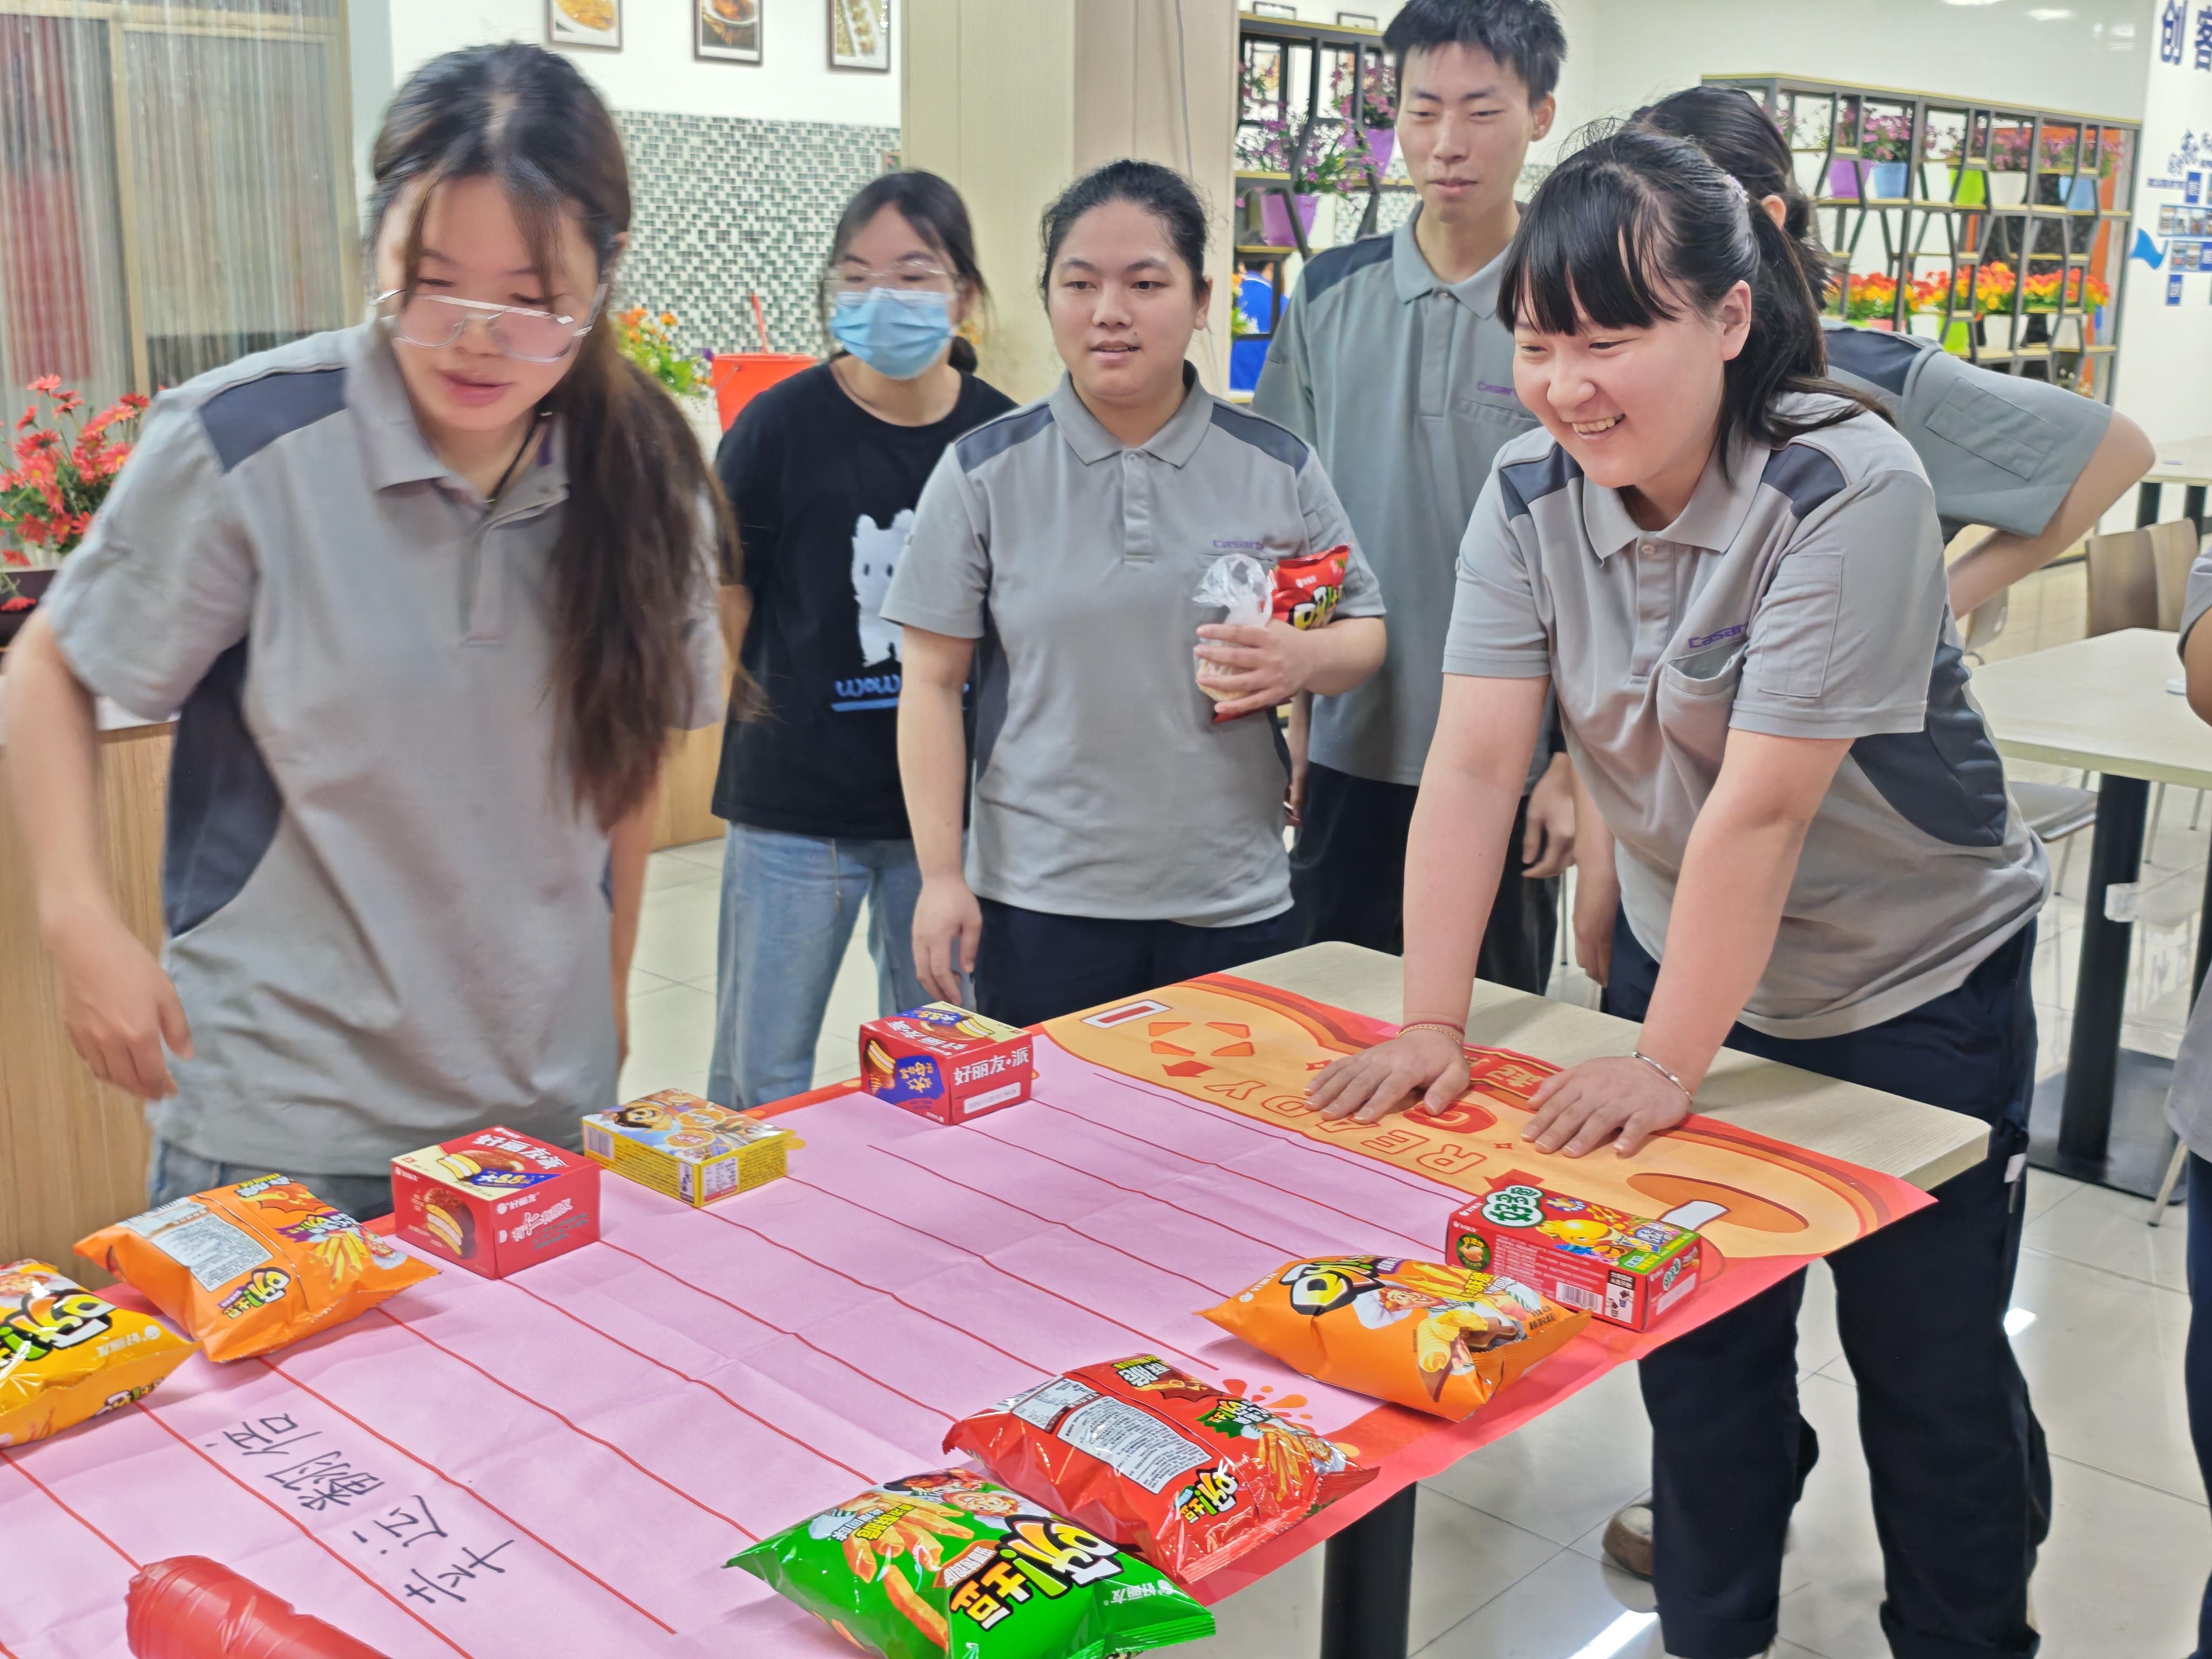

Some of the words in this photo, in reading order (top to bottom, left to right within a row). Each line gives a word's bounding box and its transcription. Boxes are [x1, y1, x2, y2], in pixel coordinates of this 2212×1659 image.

[1488, 1187, 1539, 1223] 好多鱼
[205, 1413, 515, 1603] 幸运翻倍
